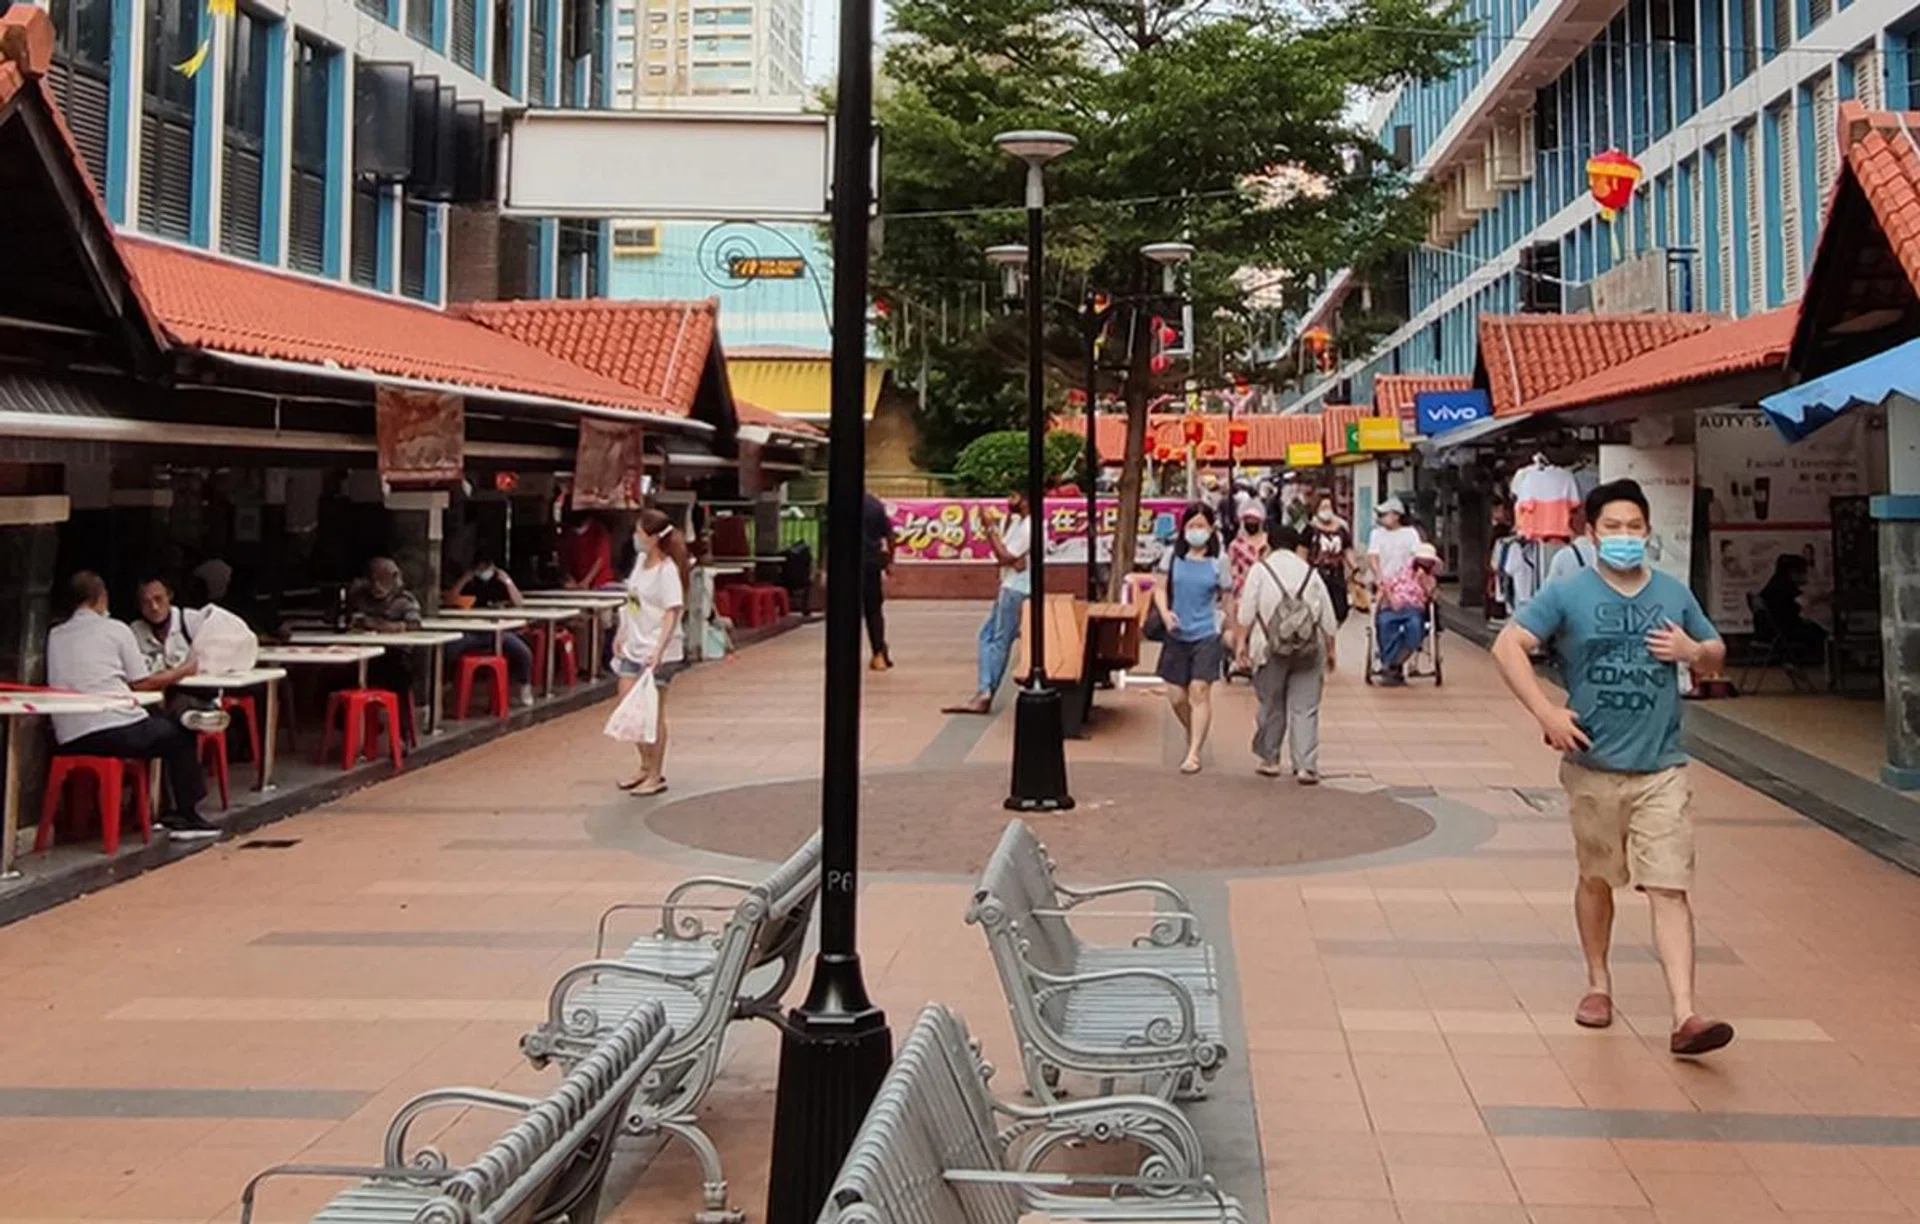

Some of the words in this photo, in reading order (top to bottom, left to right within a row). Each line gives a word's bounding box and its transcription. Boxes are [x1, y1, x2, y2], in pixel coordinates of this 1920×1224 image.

[1428, 405, 1478, 421] vivo
[1595, 602, 1664, 635] SIX
[1597, 689, 1657, 711] SOON
